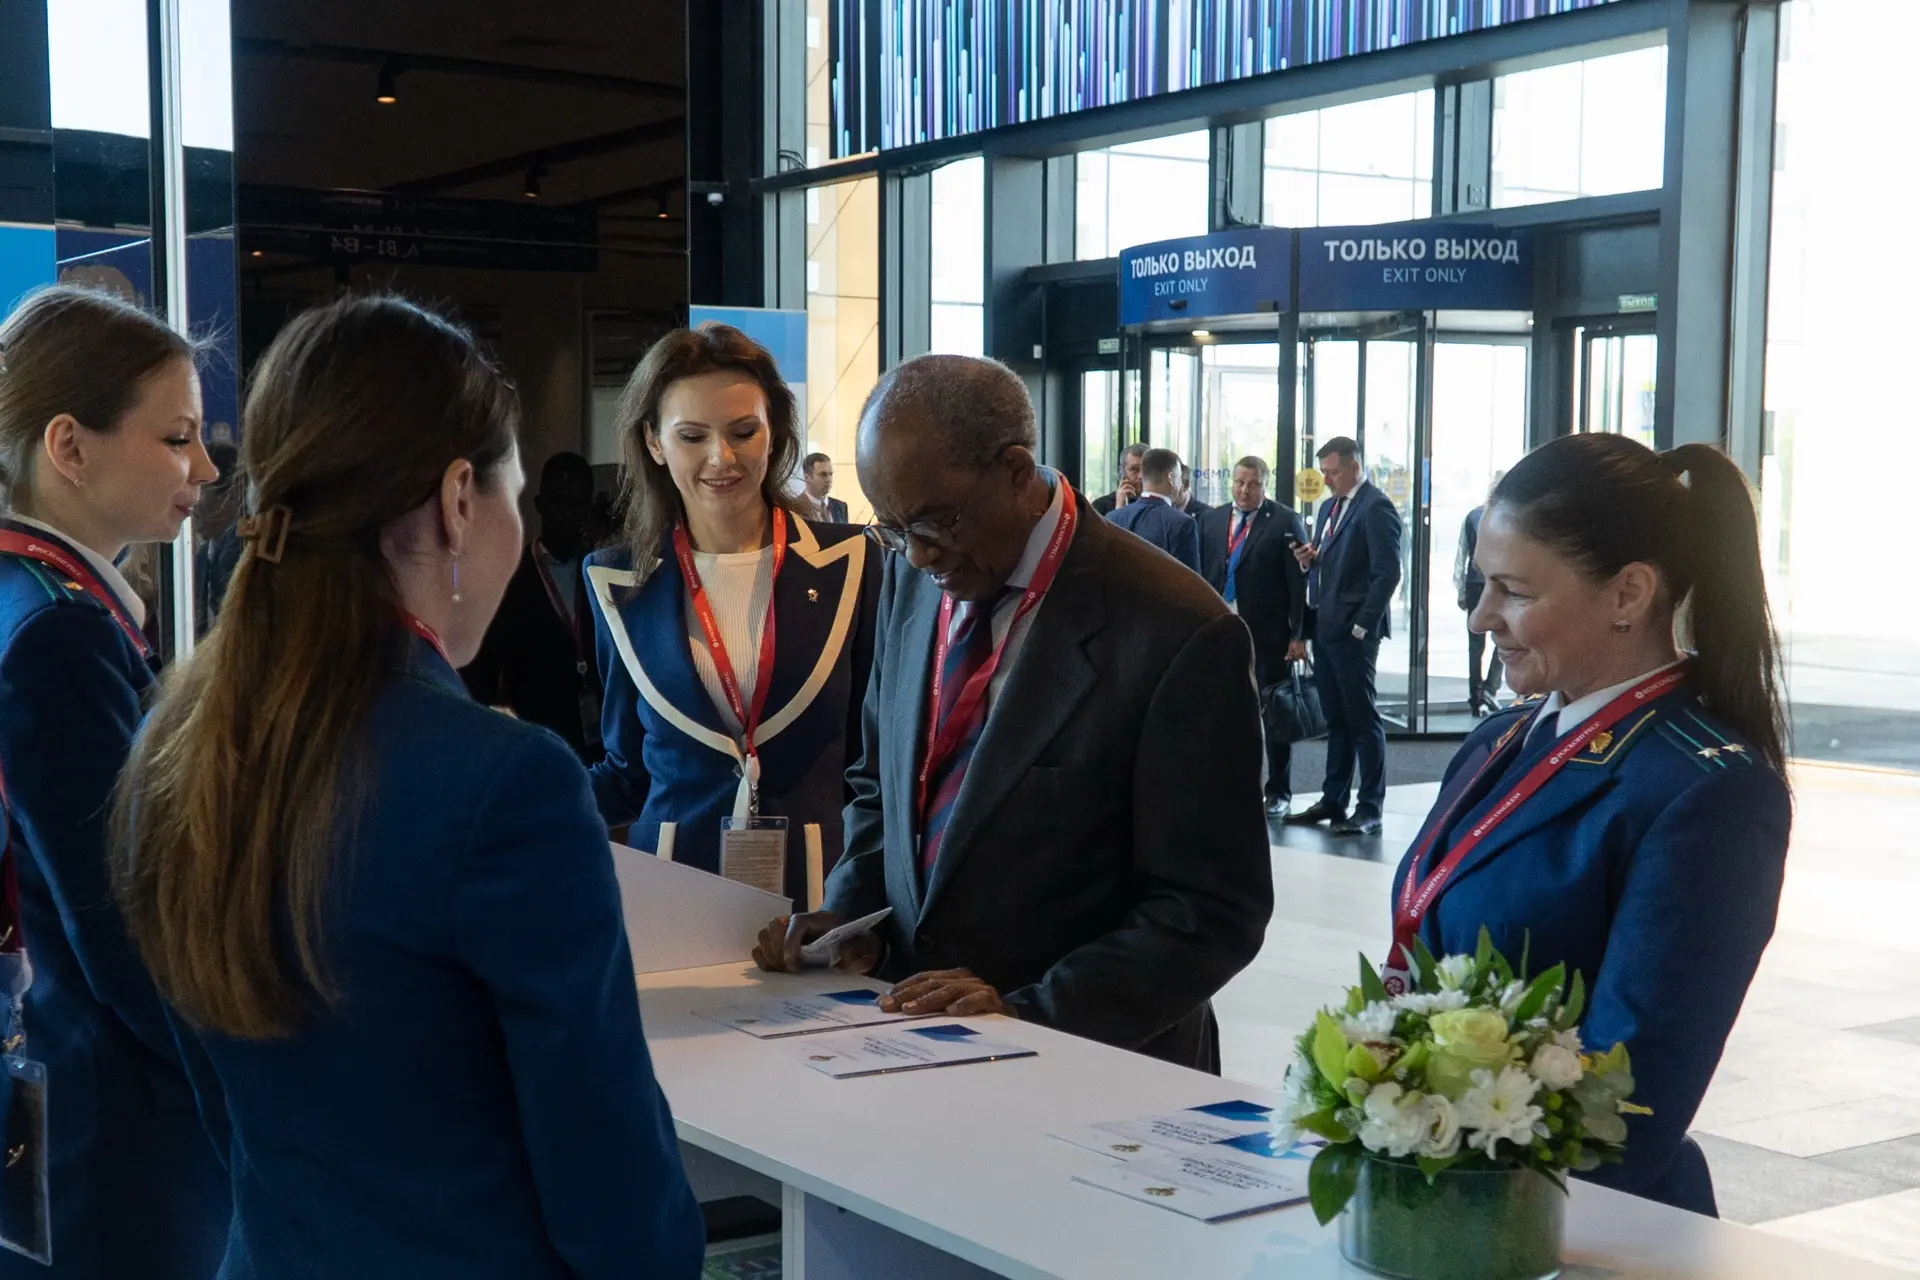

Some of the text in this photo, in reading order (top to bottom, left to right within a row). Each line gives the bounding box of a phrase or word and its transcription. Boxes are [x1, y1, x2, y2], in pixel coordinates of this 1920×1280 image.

[1131, 245, 1257, 279] ТОЛЬКО ВЫХОД
[1324, 238, 1519, 264] ТОЛЬКО ВЫХОД
[1154, 277, 1208, 296] EXIT ONLY
[1383, 268, 1467, 283] EXIT ONLY
